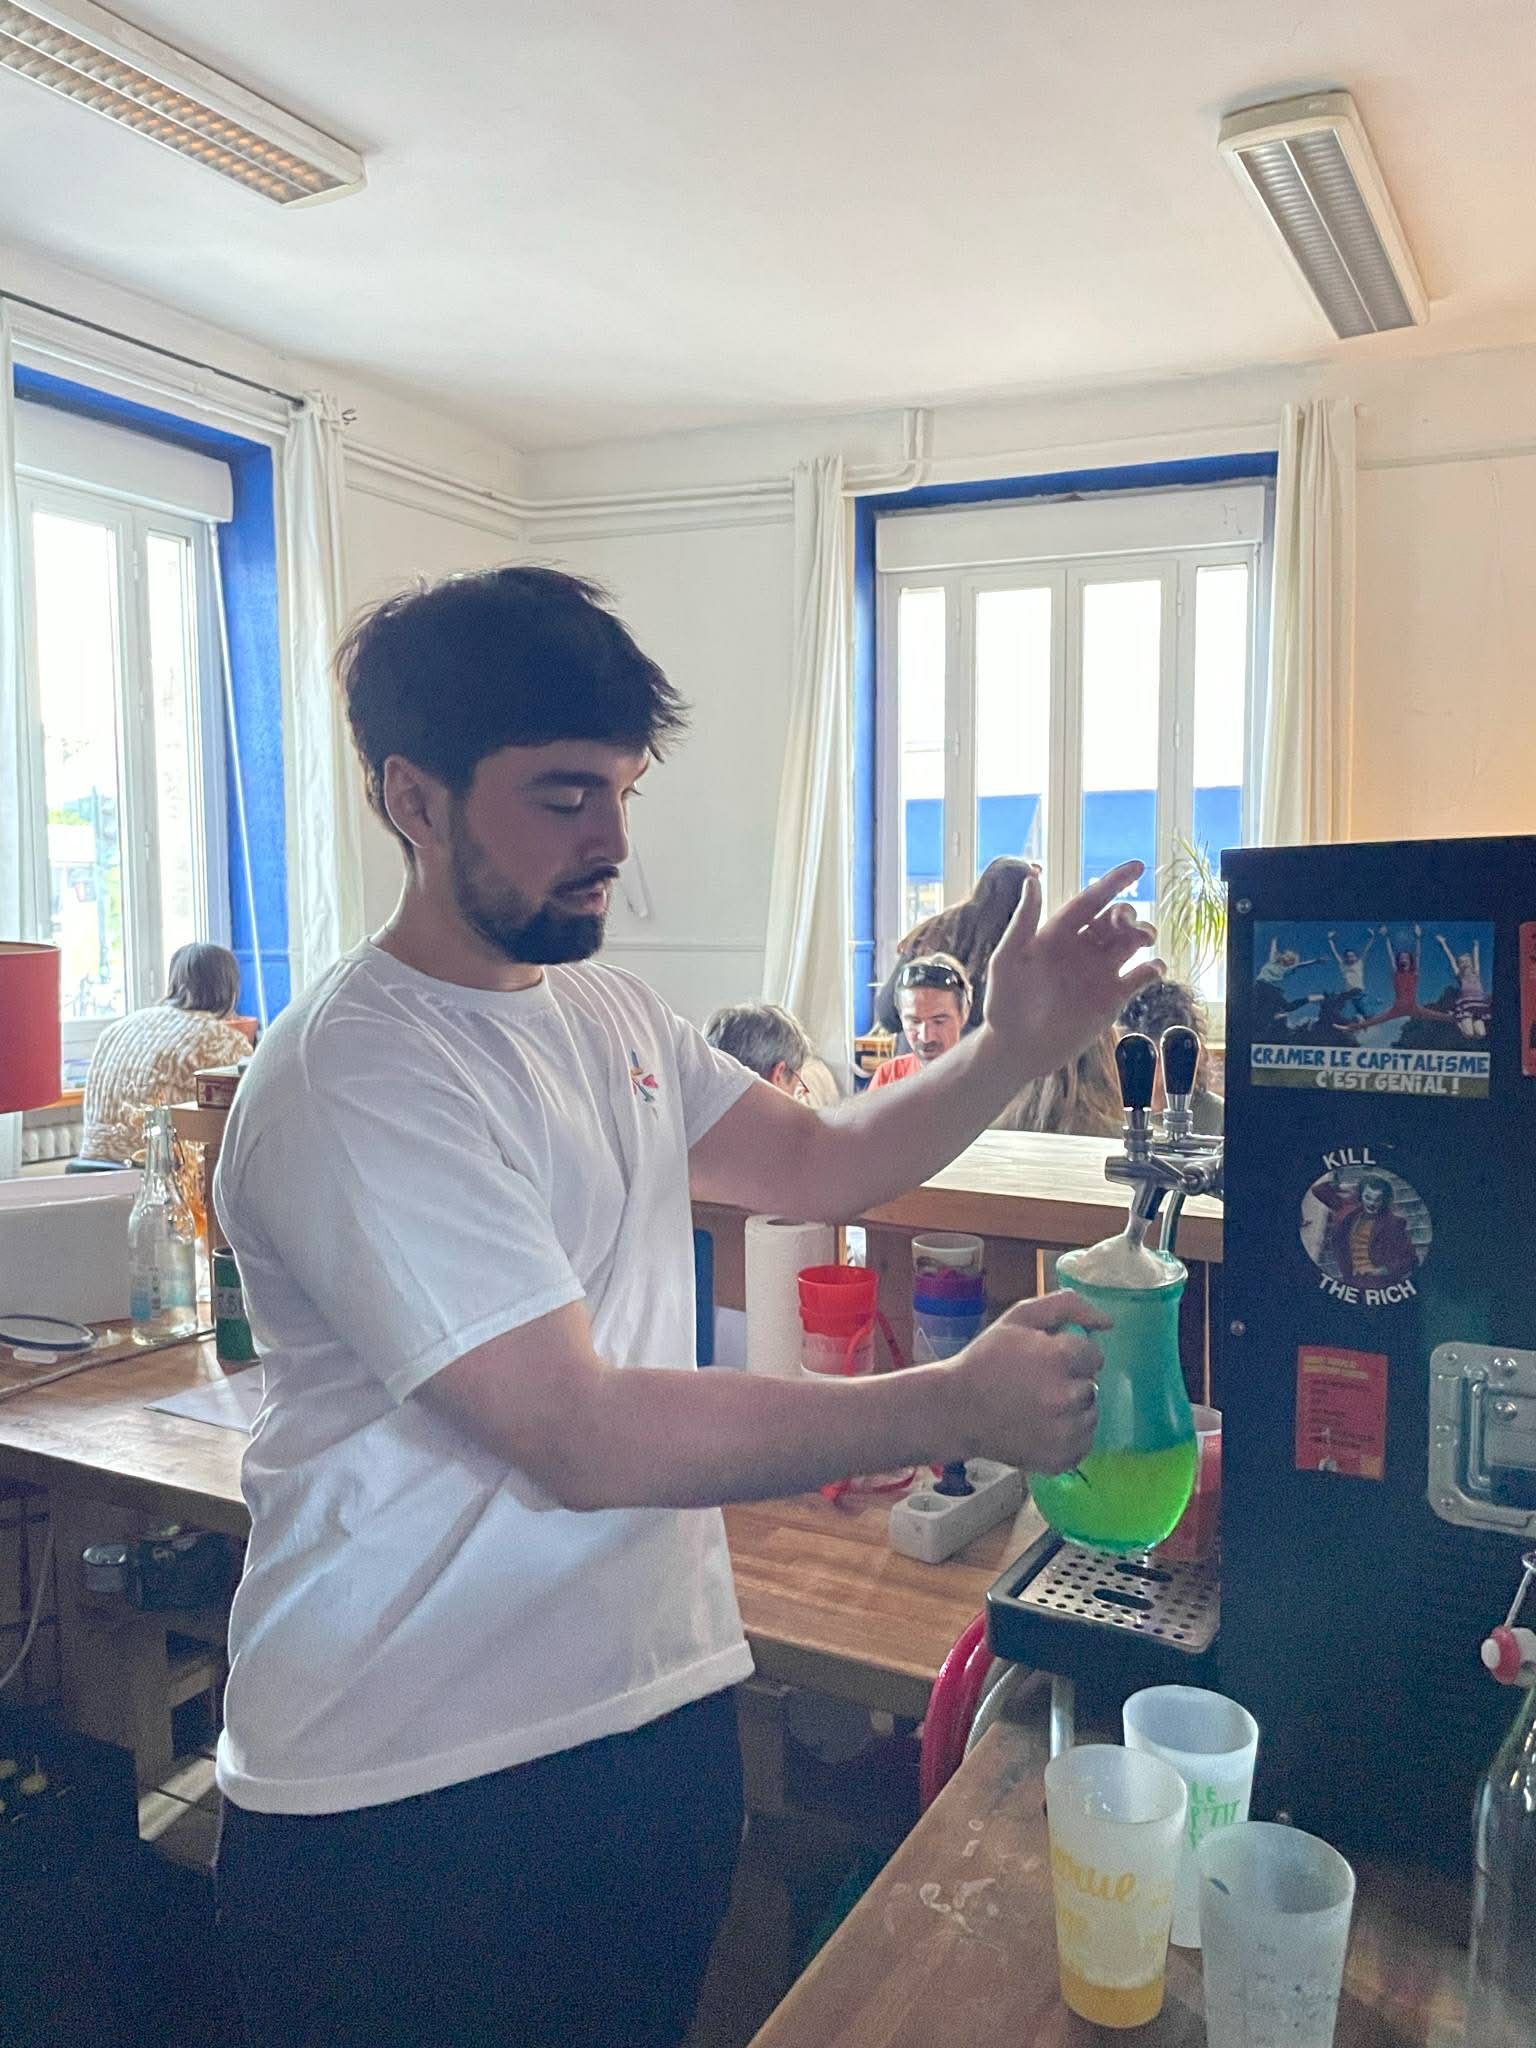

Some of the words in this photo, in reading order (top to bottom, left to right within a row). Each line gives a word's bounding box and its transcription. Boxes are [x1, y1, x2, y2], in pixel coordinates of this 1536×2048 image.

[1252, 1047, 1325, 1066] CRAMER
[1330, 1051, 1351, 1068] LE
[1315, 1070, 1369, 1089] C'EST
[1322, 1148, 1376, 1170] KILL
[1319, 1272, 1359, 1304] THE
[1365, 1279, 1417, 1306] RICH
